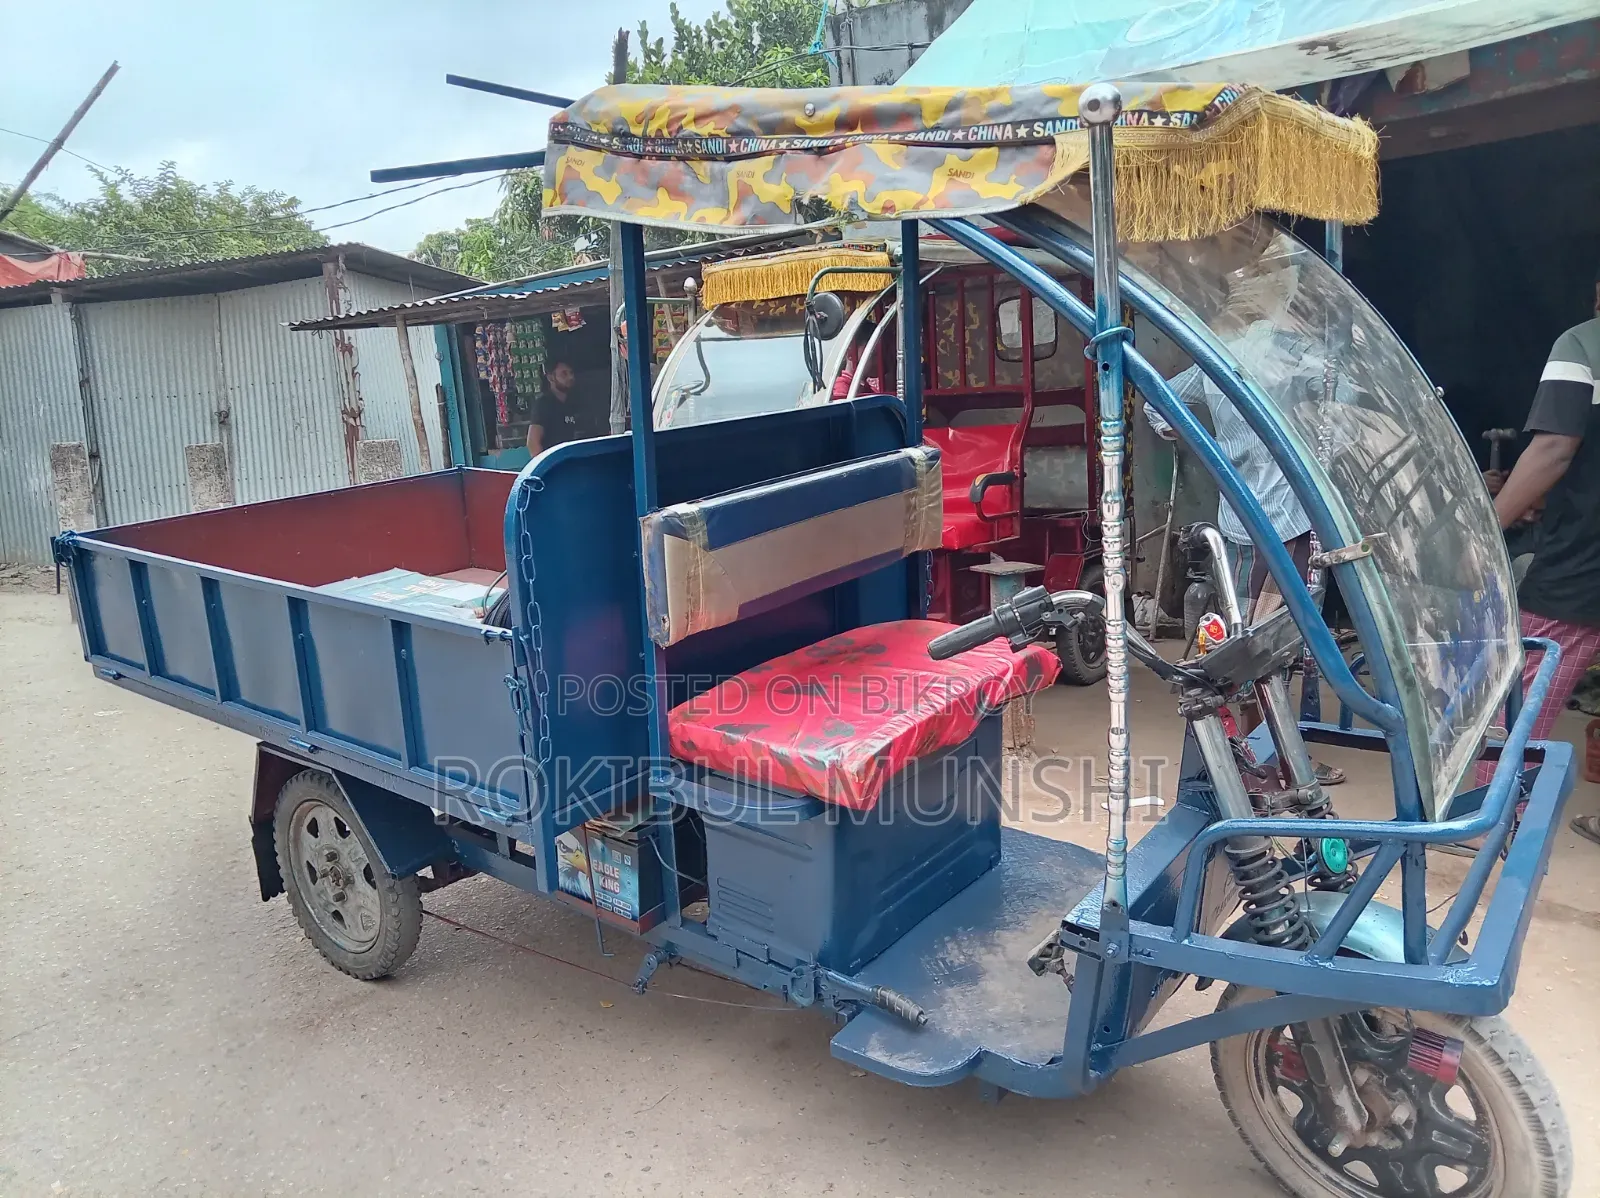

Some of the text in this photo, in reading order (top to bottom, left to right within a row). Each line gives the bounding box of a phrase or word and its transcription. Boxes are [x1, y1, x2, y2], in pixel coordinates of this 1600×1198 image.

[694, 138, 727, 154] SANDI
[740, 138, 776, 153] CHINA
[791, 138, 832, 150] SANDI
[905, 130, 952, 142] SANDI
[967, 123, 1013, 141] CHINA
[1032, 118, 1081, 138] SANDI
[736, 170, 755, 179] SANDI
[947, 167, 974, 180] SANDI
[592, 859, 620, 879] EAGLE
[598, 875, 621, 894] KING
